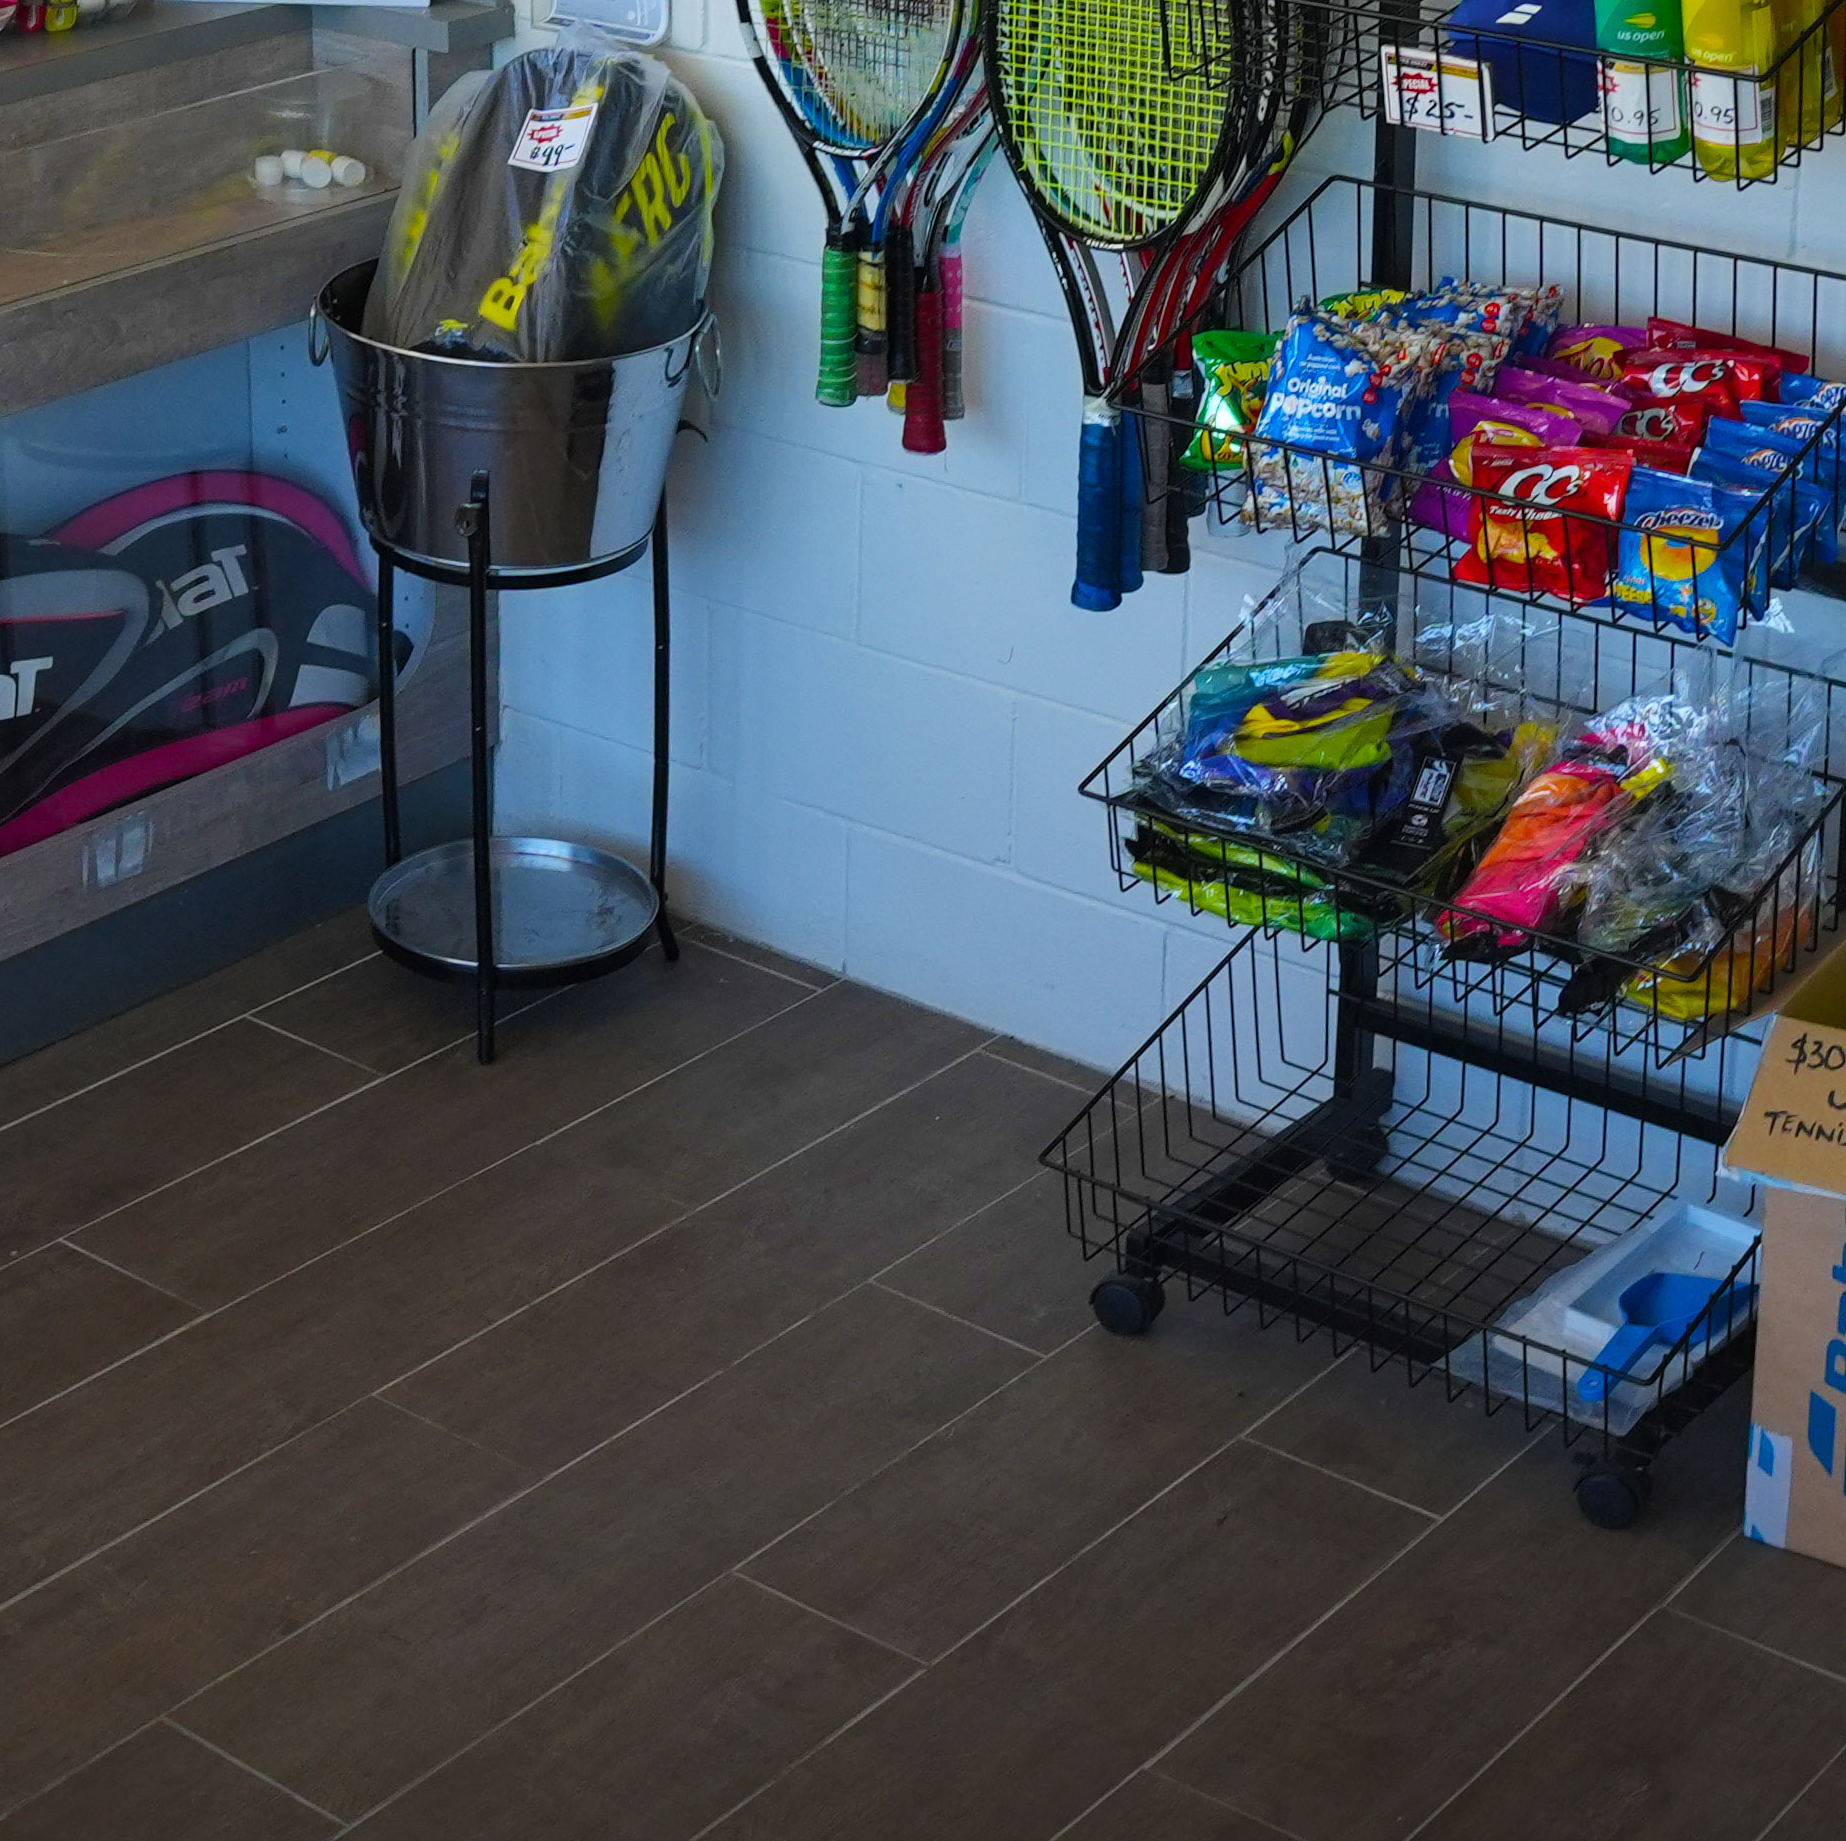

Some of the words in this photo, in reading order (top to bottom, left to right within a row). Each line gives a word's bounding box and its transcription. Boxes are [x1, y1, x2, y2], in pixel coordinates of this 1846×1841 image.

[1632, 28, 1666, 44] open
[1287, 375, 1349, 399] Original
[1271, 392, 1362, 420] Popcorn
[1784, 1033, 1846, 1075] $30
